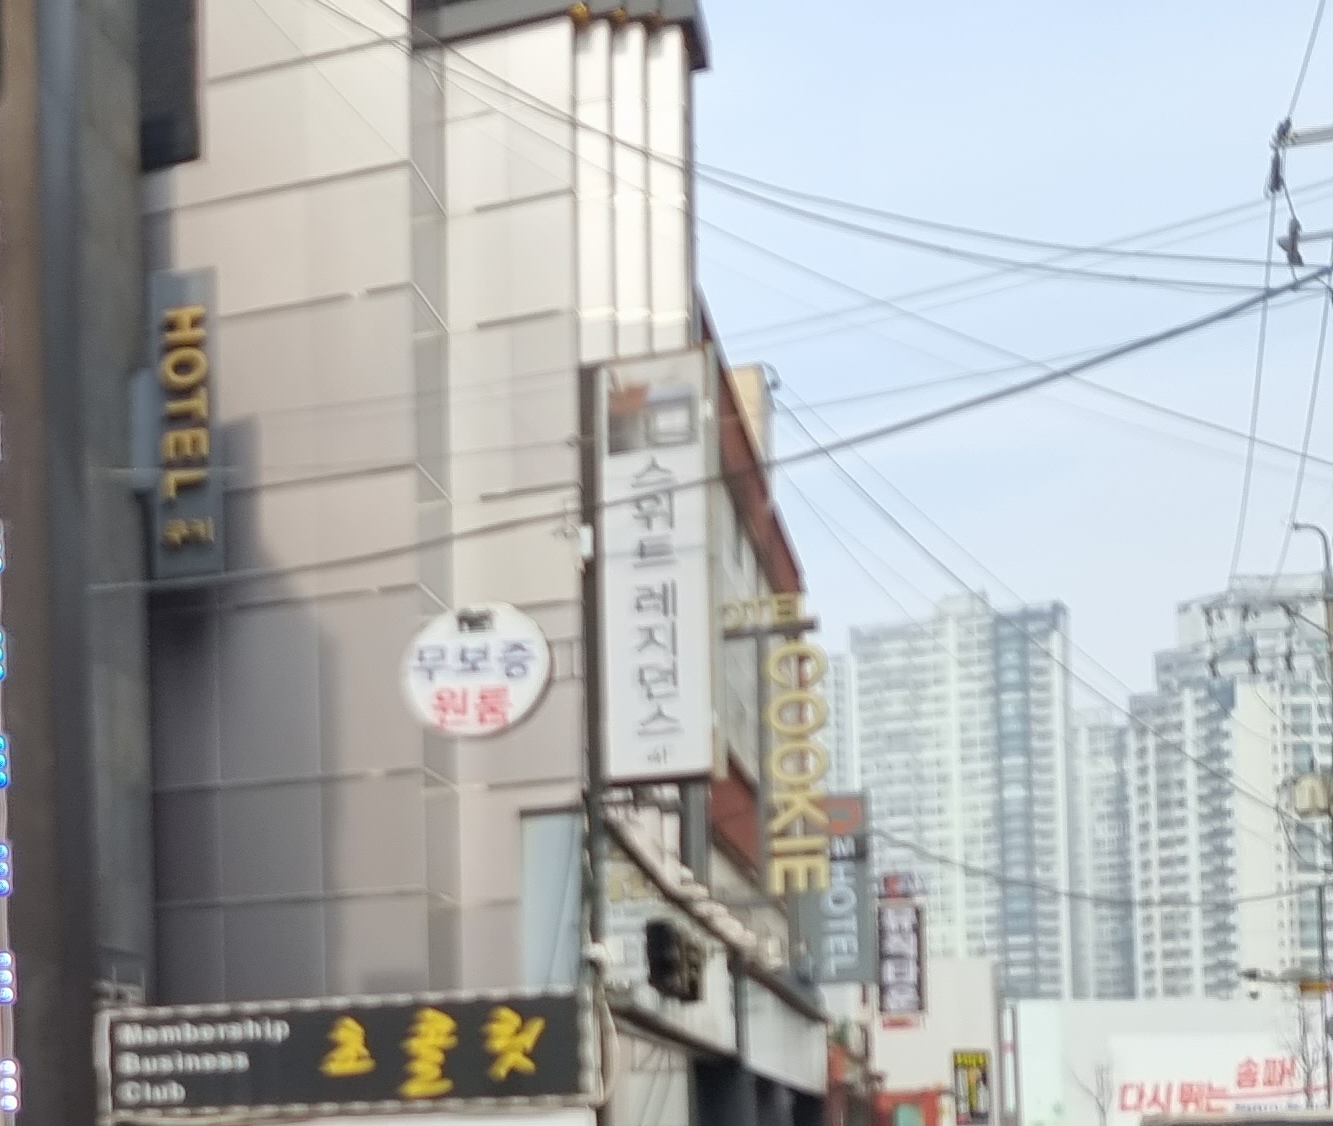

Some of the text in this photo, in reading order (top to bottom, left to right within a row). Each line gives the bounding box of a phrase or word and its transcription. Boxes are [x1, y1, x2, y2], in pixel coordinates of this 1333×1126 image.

[160, 303, 210, 499] HOTEL
[413, 641, 533, 681] 무보증
[767, 642, 830, 896] COOKIE
[821, 860, 859, 977] HOTEL
[114, 1080, 187, 1106] Club
